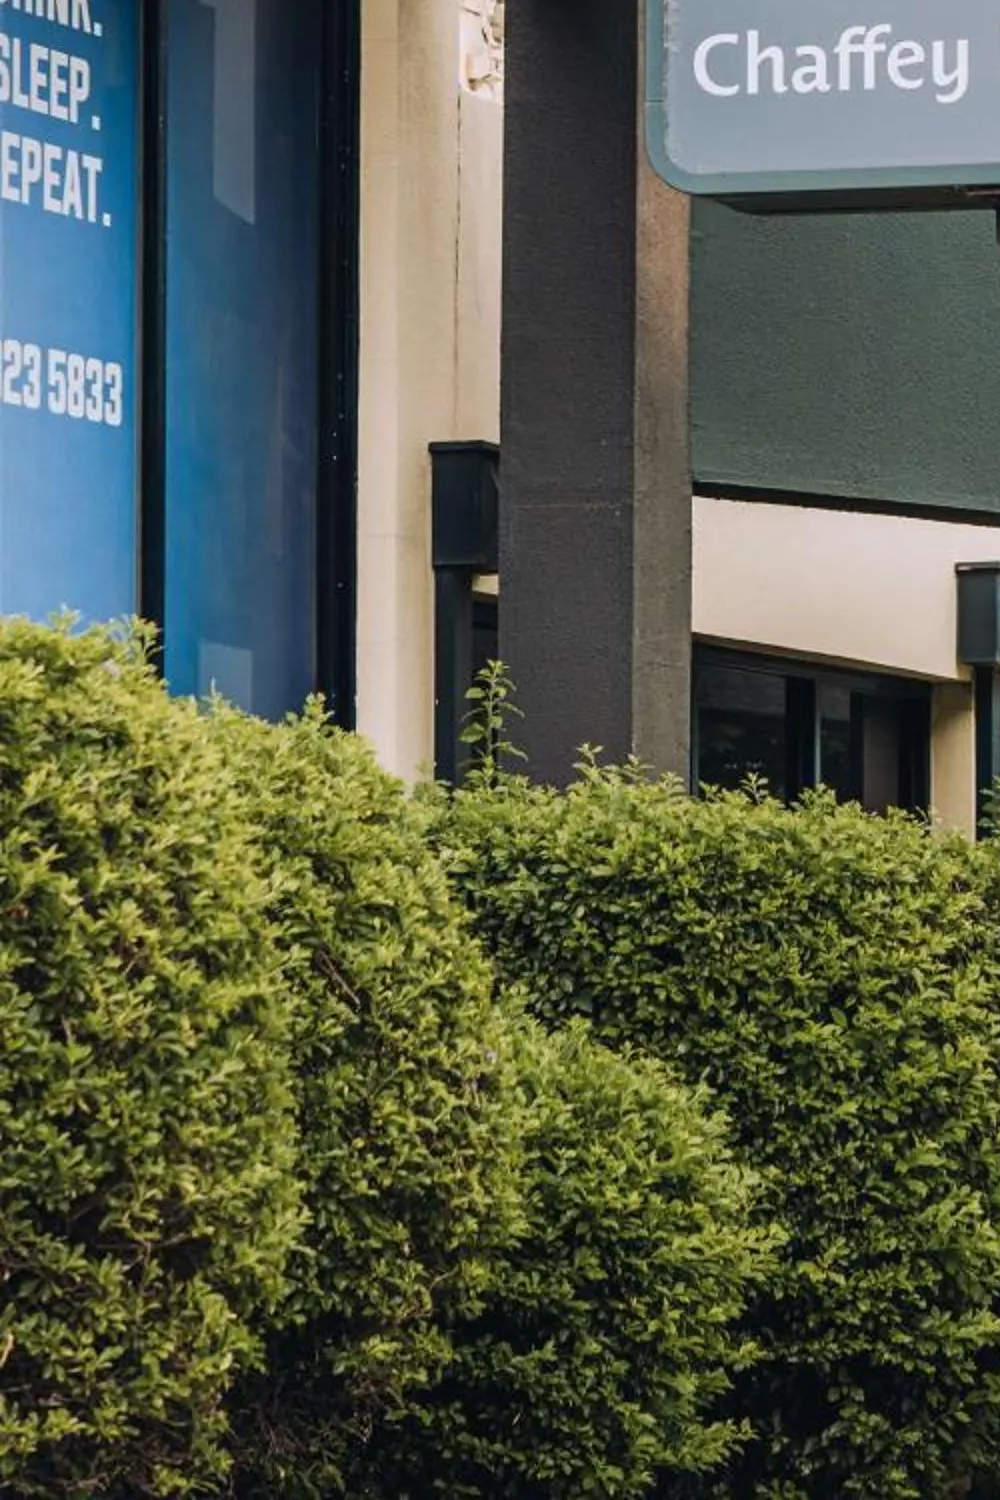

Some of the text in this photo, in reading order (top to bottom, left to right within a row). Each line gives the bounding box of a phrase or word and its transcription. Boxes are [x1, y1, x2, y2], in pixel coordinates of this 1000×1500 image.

[692, 22, 969, 104] Chaffey
[0, 337, 122, 427] 23 5833
